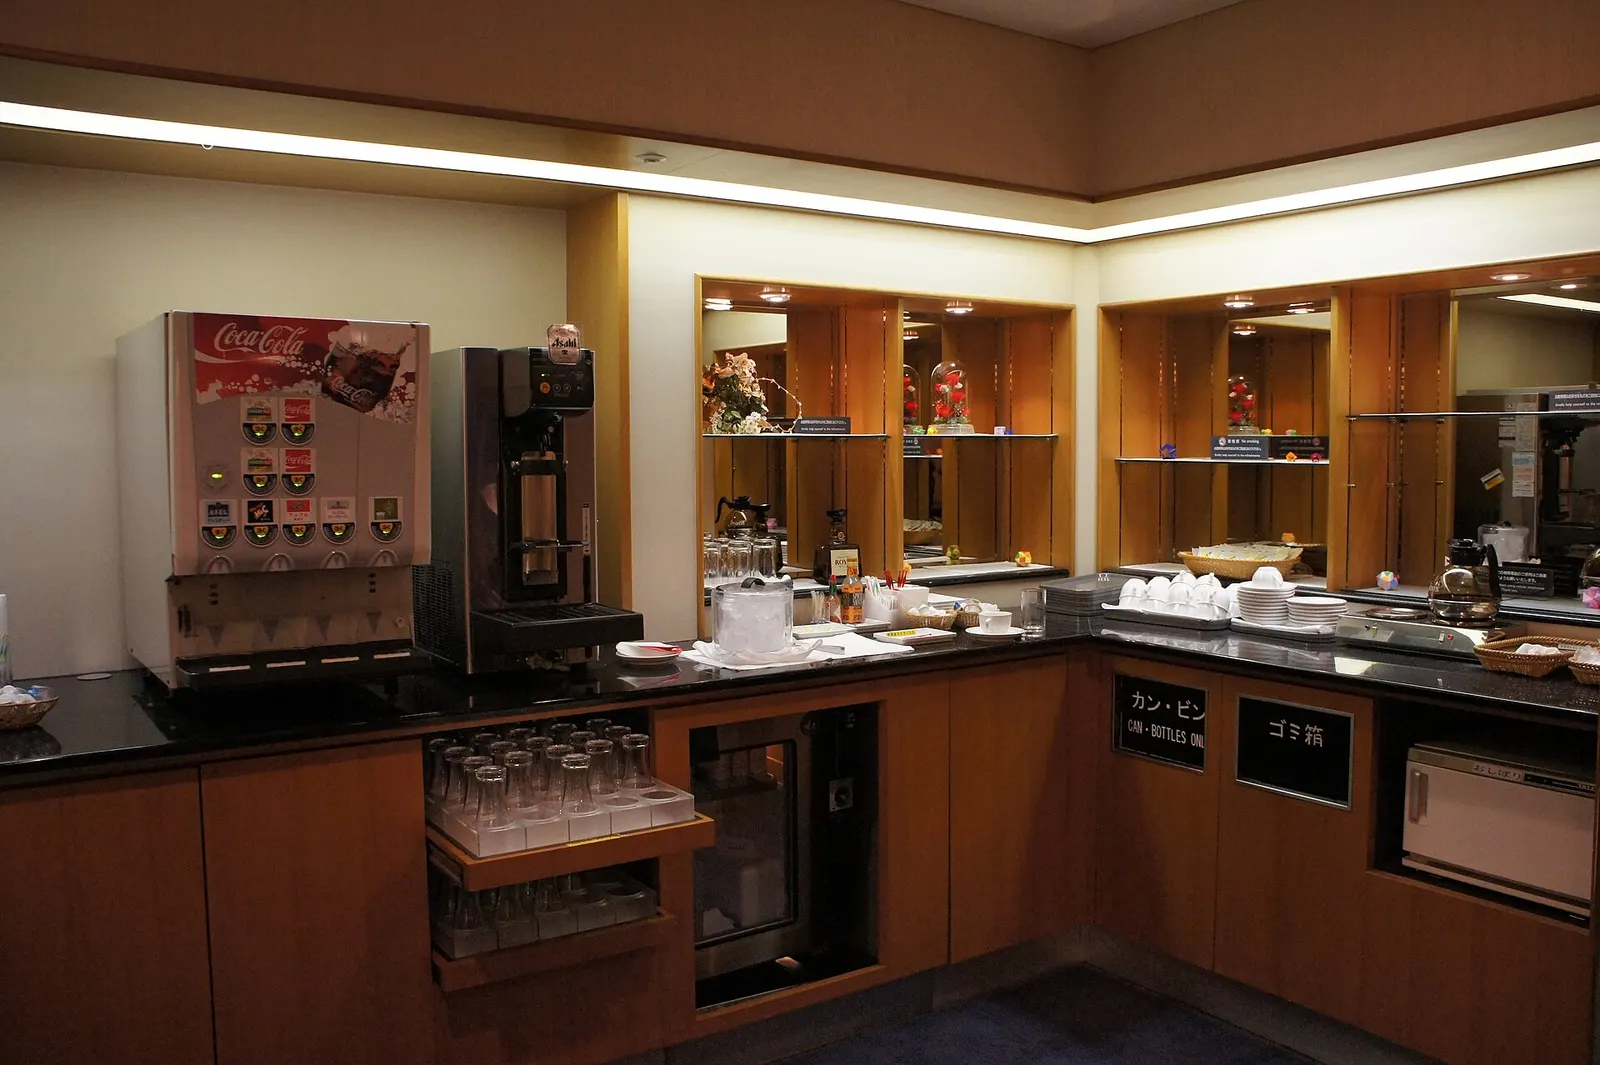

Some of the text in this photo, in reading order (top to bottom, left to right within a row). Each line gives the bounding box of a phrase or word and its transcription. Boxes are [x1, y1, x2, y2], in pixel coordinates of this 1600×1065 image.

[213, 322, 309, 355] Coca-Cola
[552, 338, 577, 348] Asahi
[1131, 690, 1206, 721] カン・ビン
[1268, 718, 1324, 748] ゴミ箱
[1473, 764, 1521, 780] おしぼり
